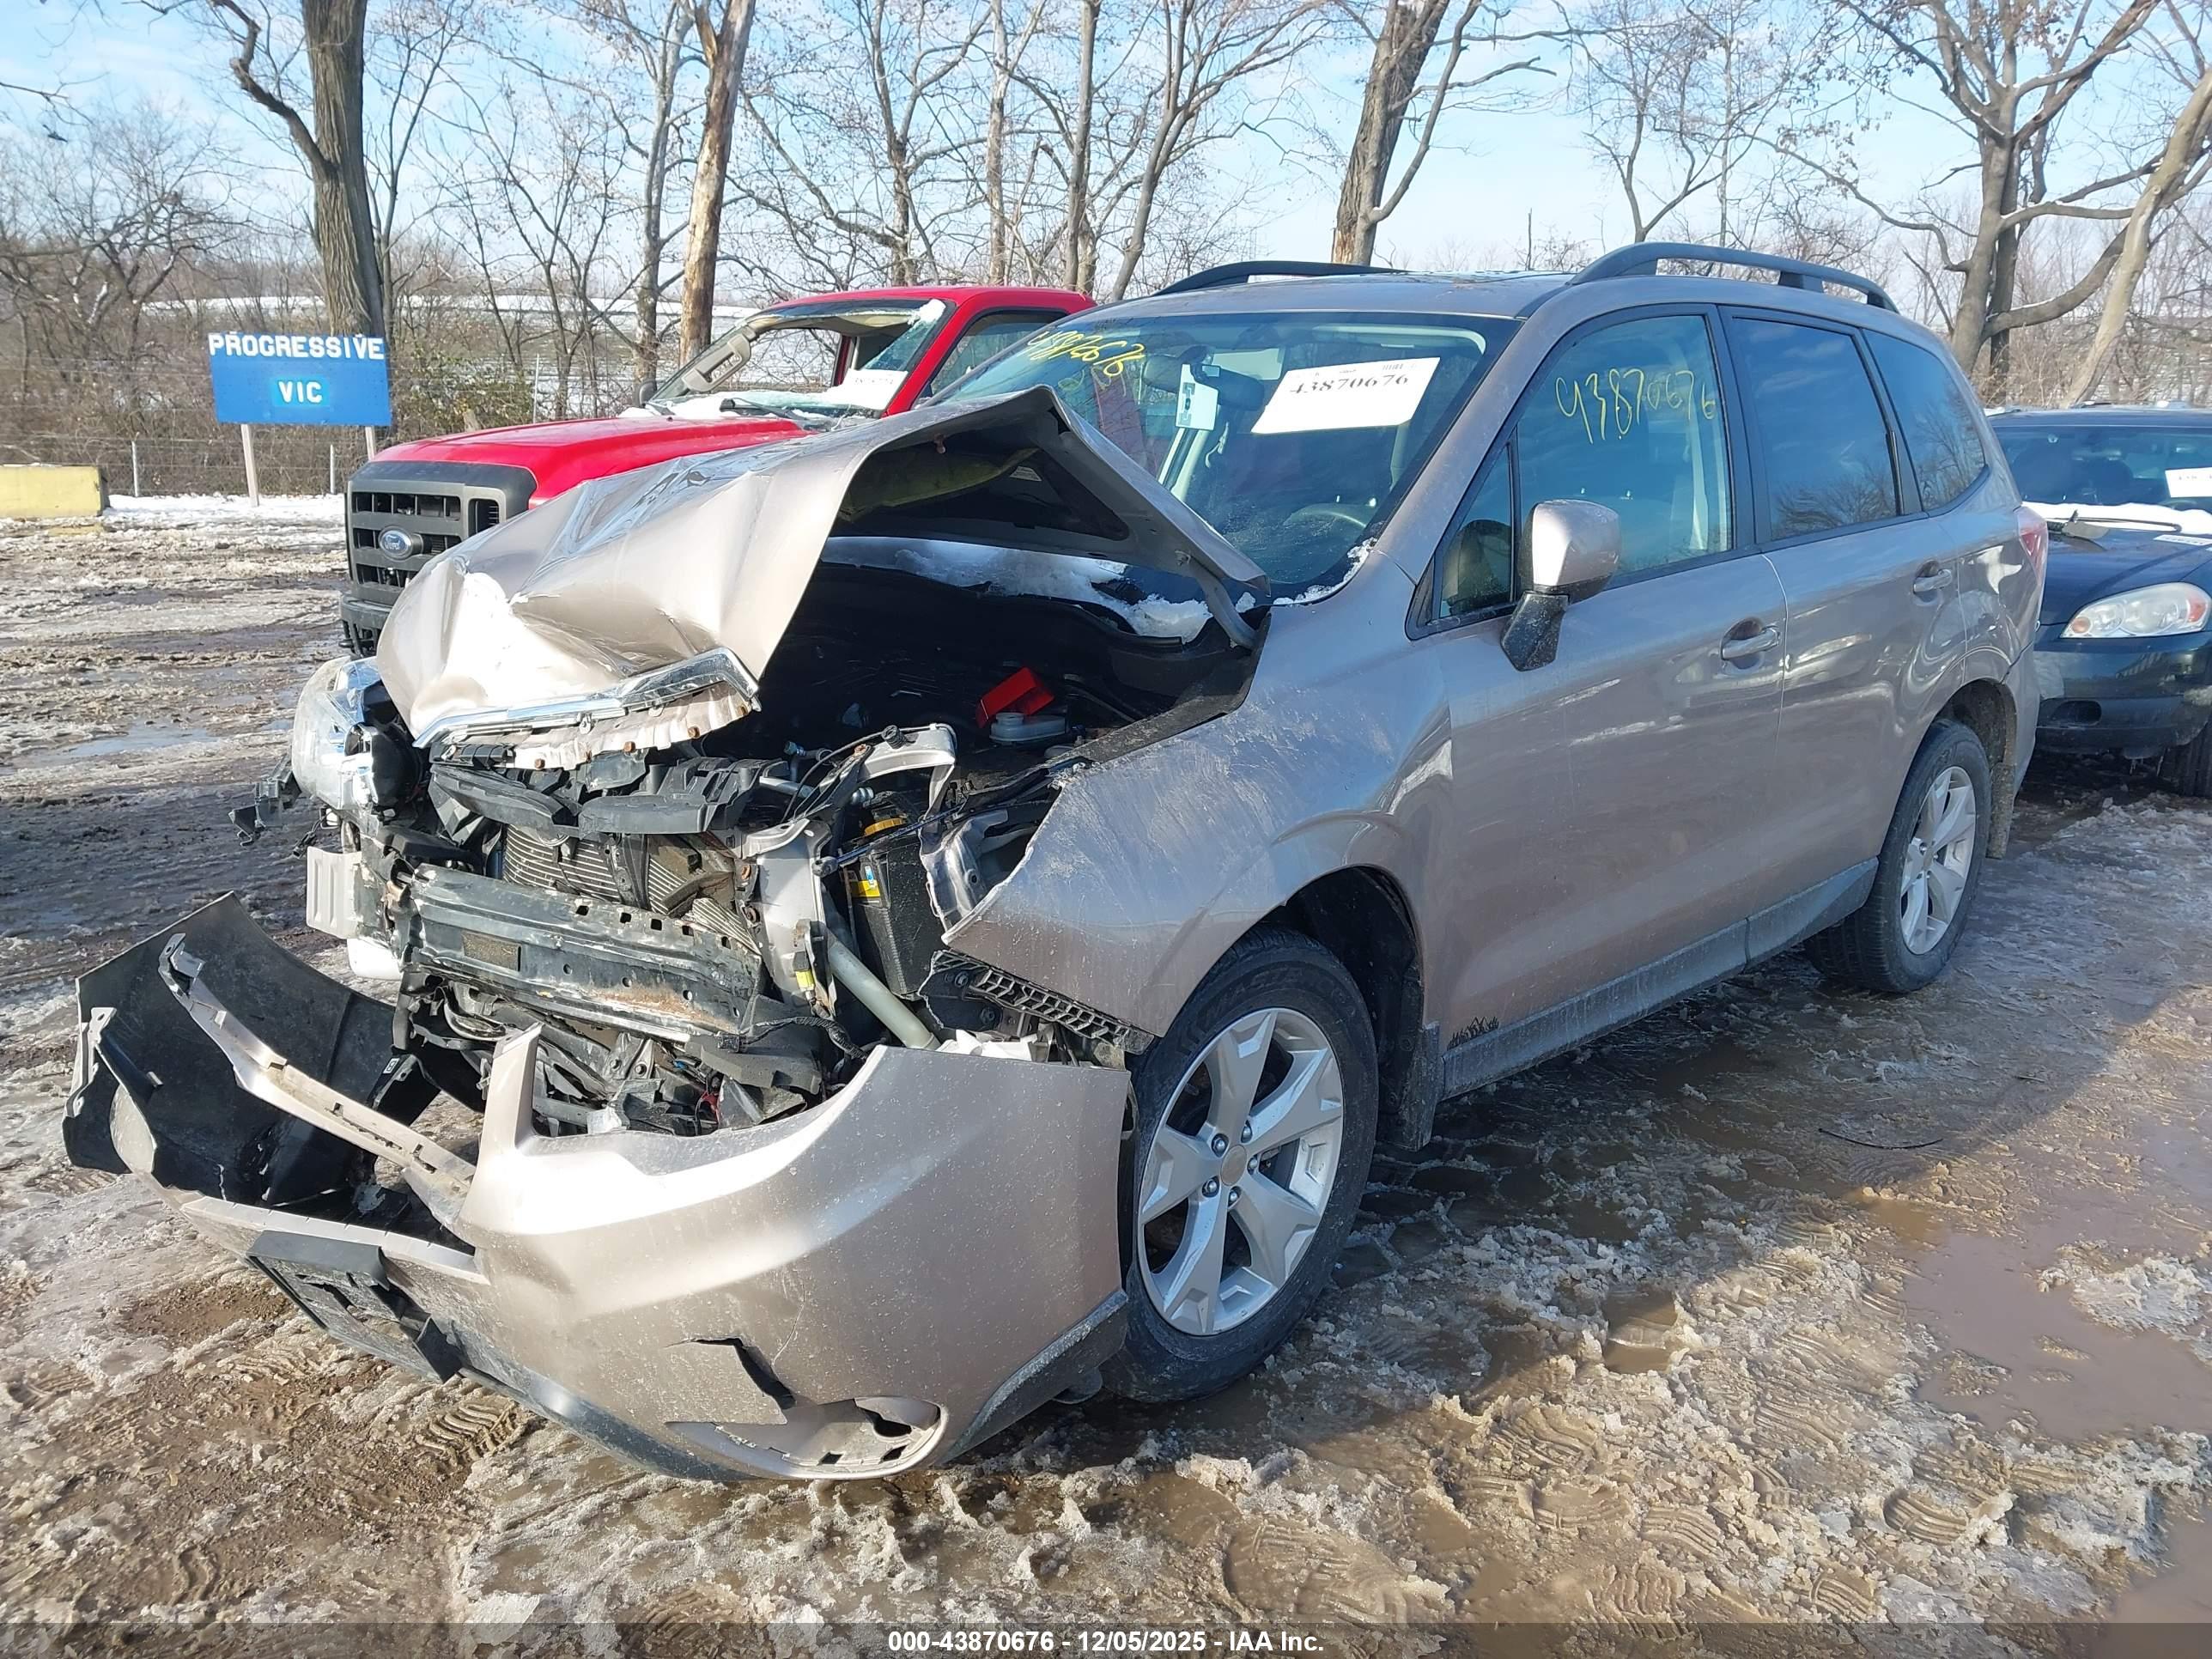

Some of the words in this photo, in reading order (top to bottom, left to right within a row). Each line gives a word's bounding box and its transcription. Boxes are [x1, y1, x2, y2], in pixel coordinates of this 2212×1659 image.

[208, 333, 385, 360] PROGRESSIVE
[277, 380, 323, 404] VIC
[1289, 373, 1409, 394] 43870676
